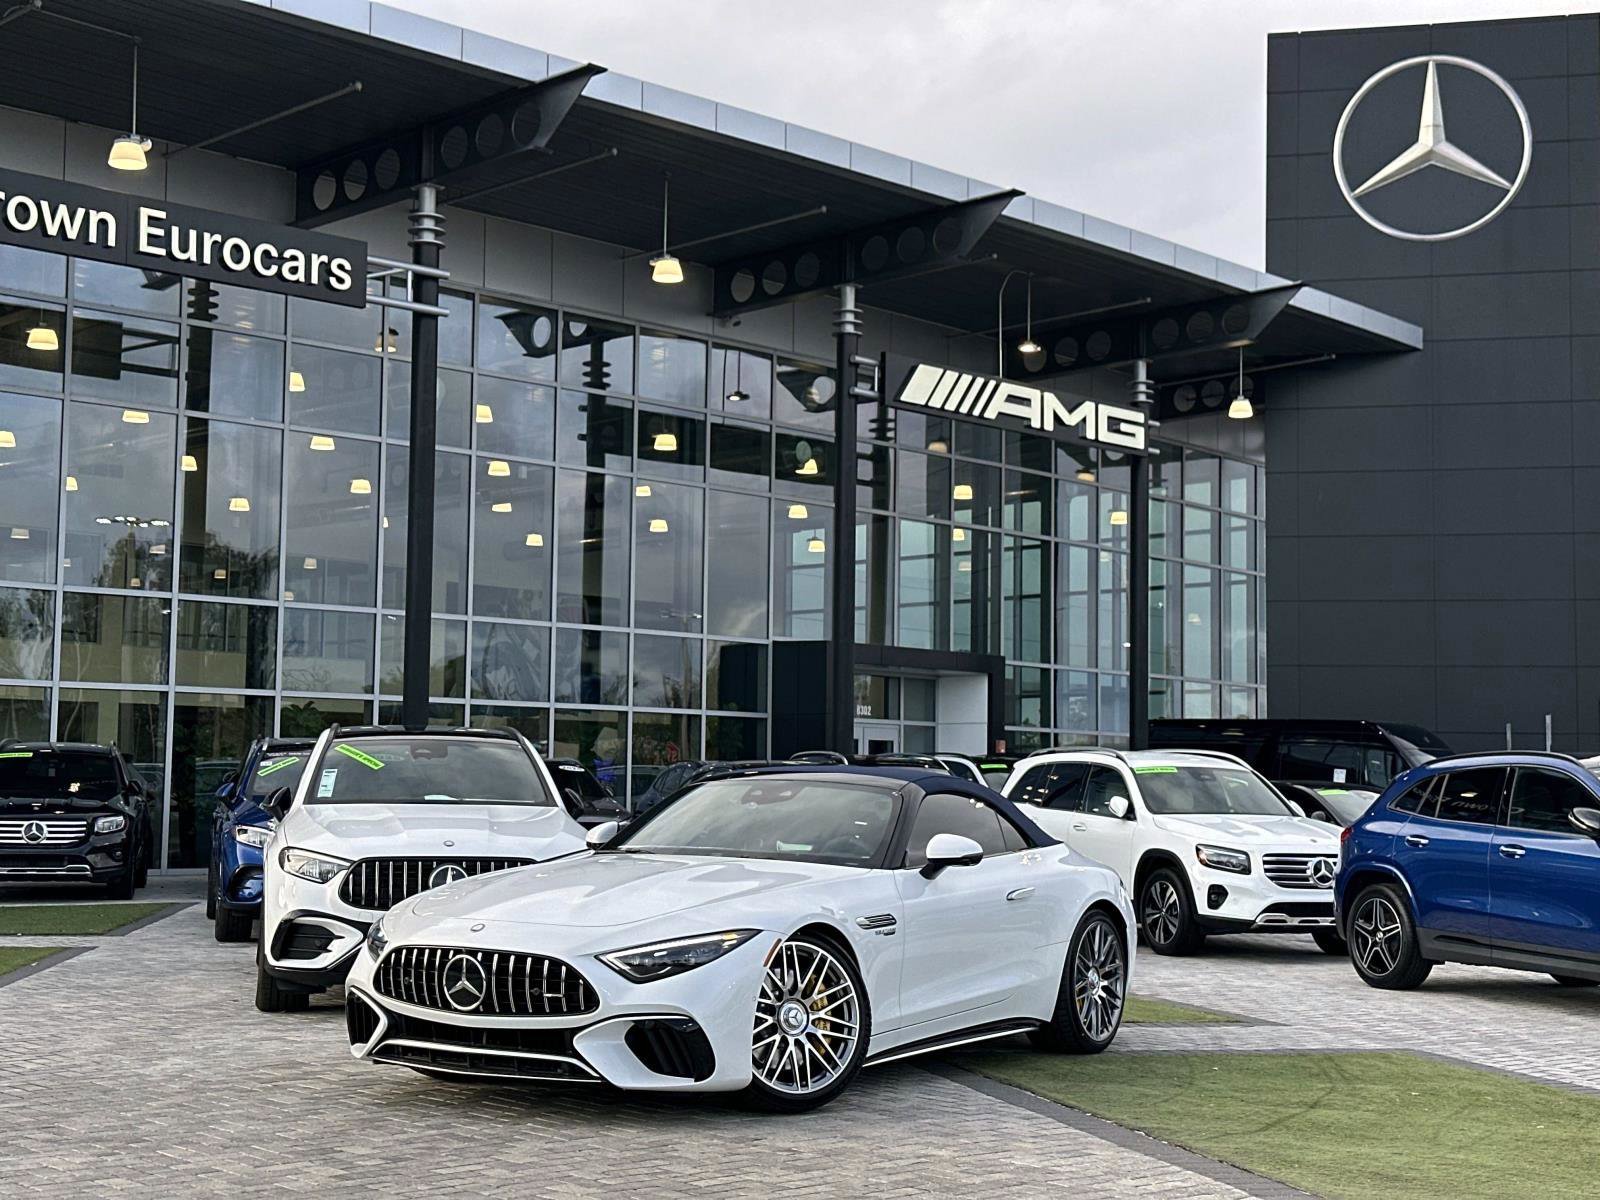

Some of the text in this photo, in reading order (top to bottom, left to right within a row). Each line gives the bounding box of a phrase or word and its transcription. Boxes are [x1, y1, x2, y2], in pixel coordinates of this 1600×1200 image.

[139, 206, 352, 291] Eurocars
[983, 382, 1145, 450] AMG
[856, 705, 872, 716] 8302
